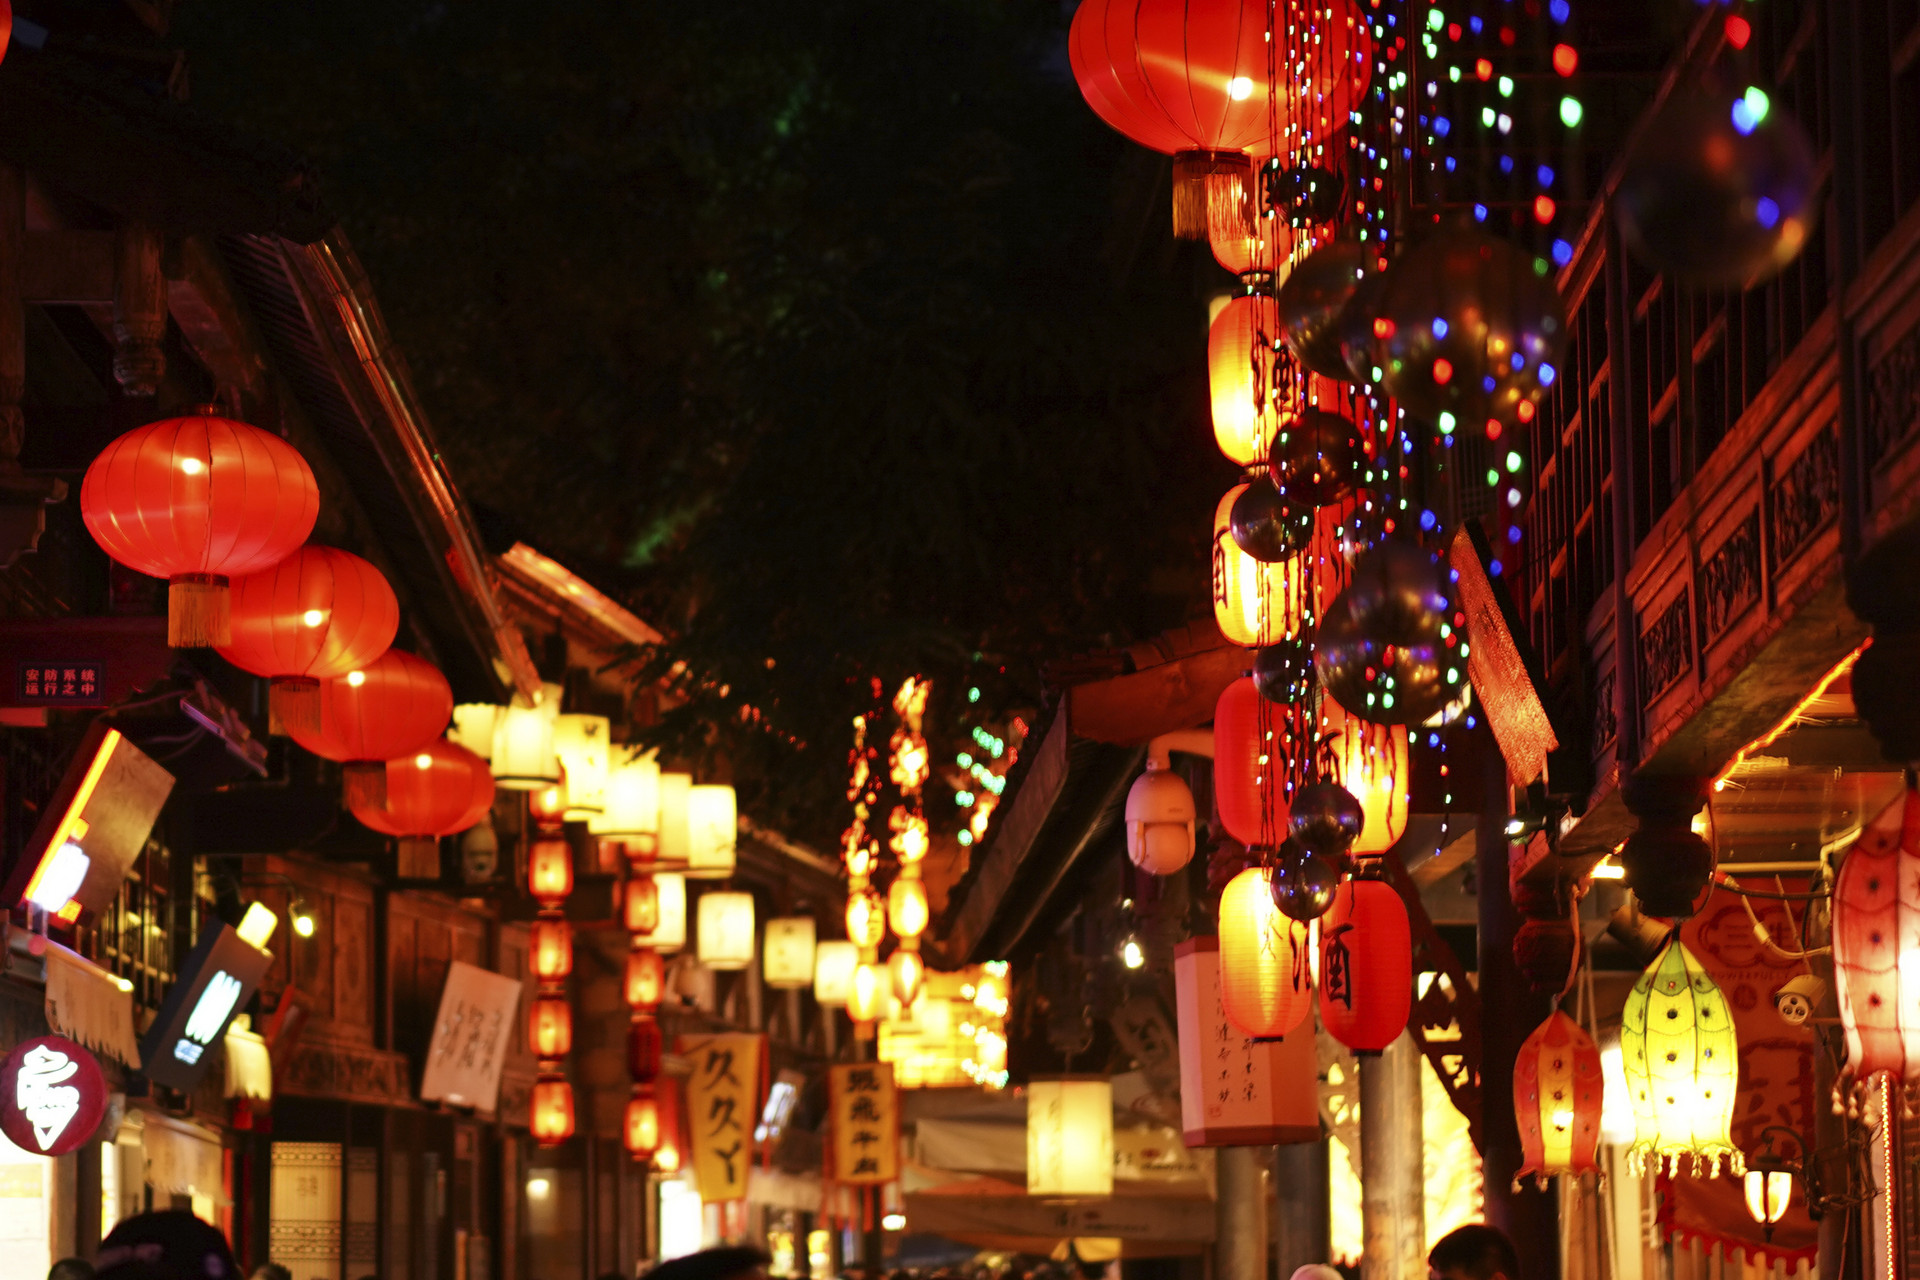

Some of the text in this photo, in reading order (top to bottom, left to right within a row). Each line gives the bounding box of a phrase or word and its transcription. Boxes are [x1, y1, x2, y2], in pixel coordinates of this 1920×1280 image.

[25, 668, 96, 682] 安防系统
[25, 682, 95, 696] 运行之中
[703, 1049, 742, 1184] 久久丫
